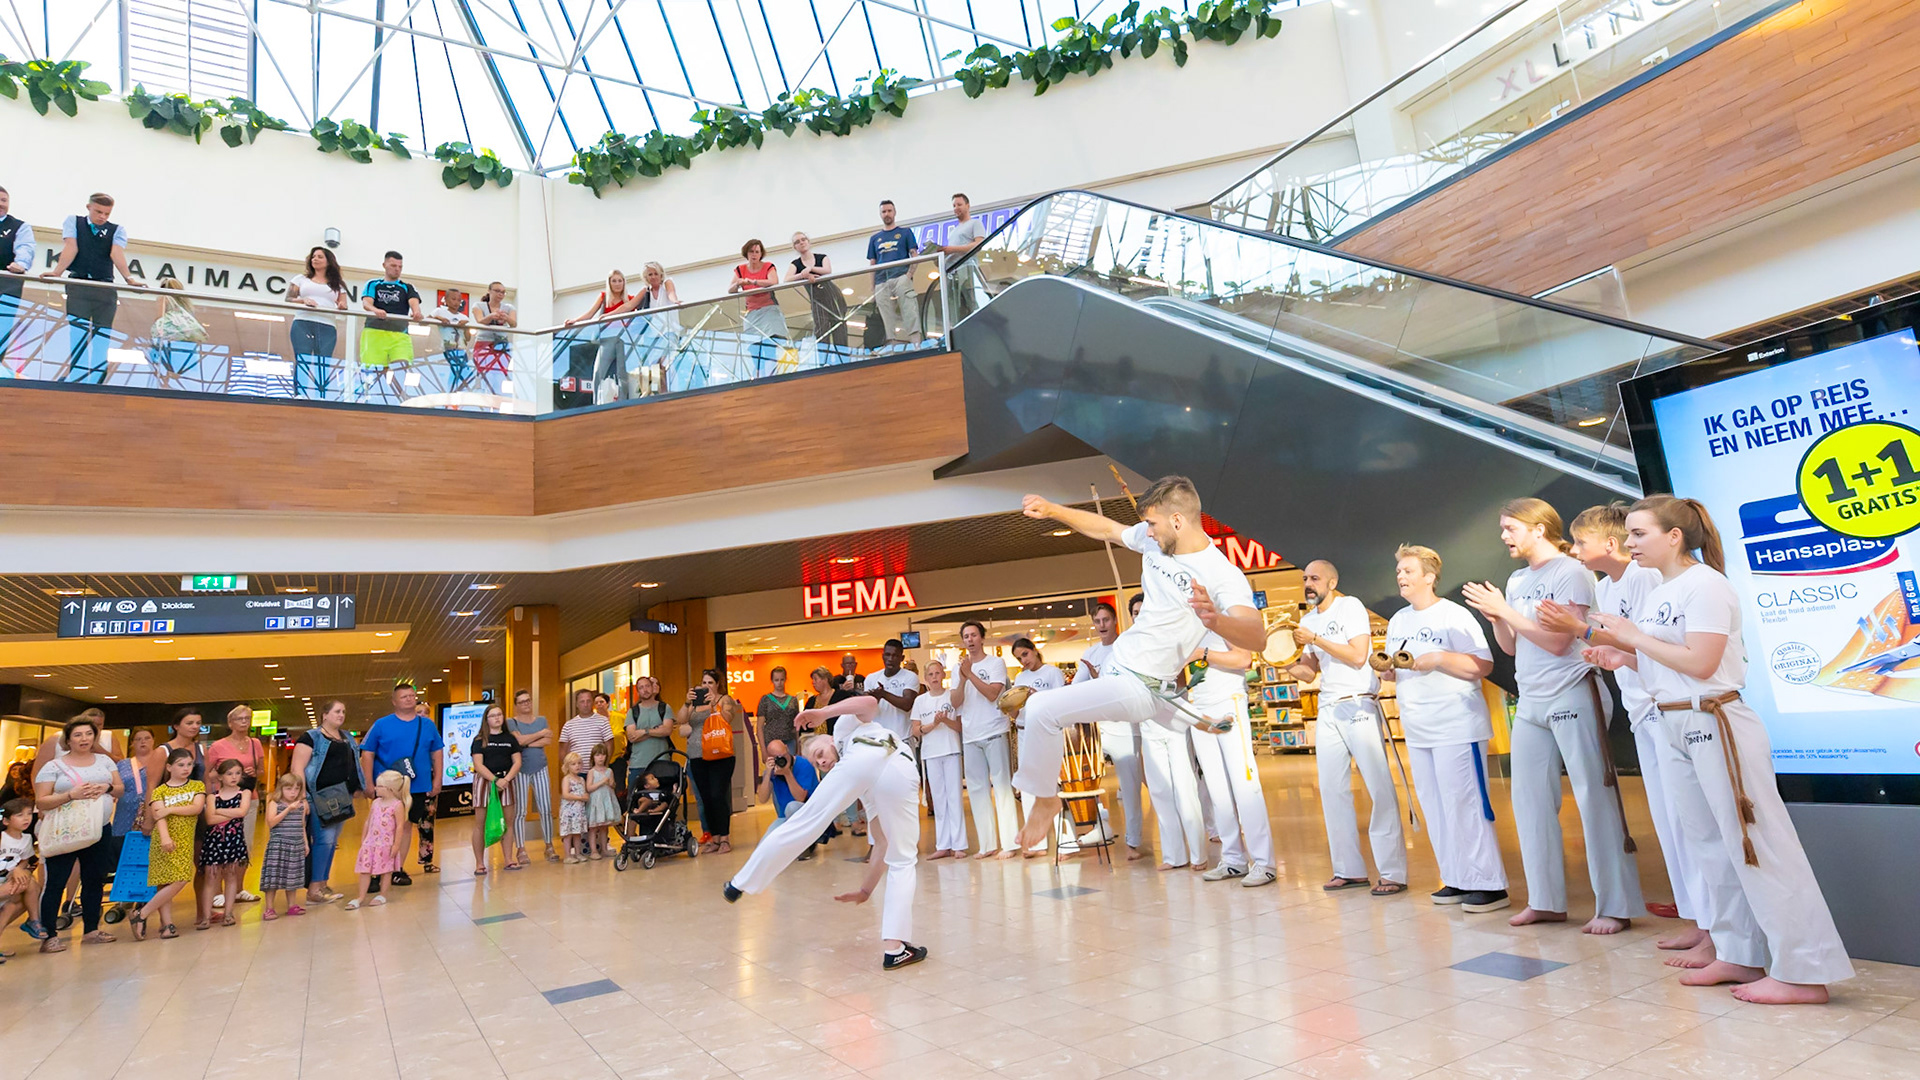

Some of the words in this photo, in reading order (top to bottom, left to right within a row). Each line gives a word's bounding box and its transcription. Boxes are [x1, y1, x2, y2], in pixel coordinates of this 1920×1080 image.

[1703, 413, 1728, 435] IK
[1731, 405, 1766, 428] GA
[1771, 394, 1803, 419] OP
[1810, 378, 1870, 410] REIS
[1708, 433, 1739, 458] EN
[1744, 416, 1813, 449] NEEM
[1812, 438, 1920, 504] 1+1
[1755, 537, 1886, 565] Hansaplast
[803, 575, 916, 619] HEMA
[1757, 582, 1858, 608] CLASSIC
[1806, 604, 1836, 612] ademen
[1761, 616, 1788, 624] Flexibel
[726, 670, 755, 683] ssa
[1773, 657, 1819, 670] ORIGINAL
